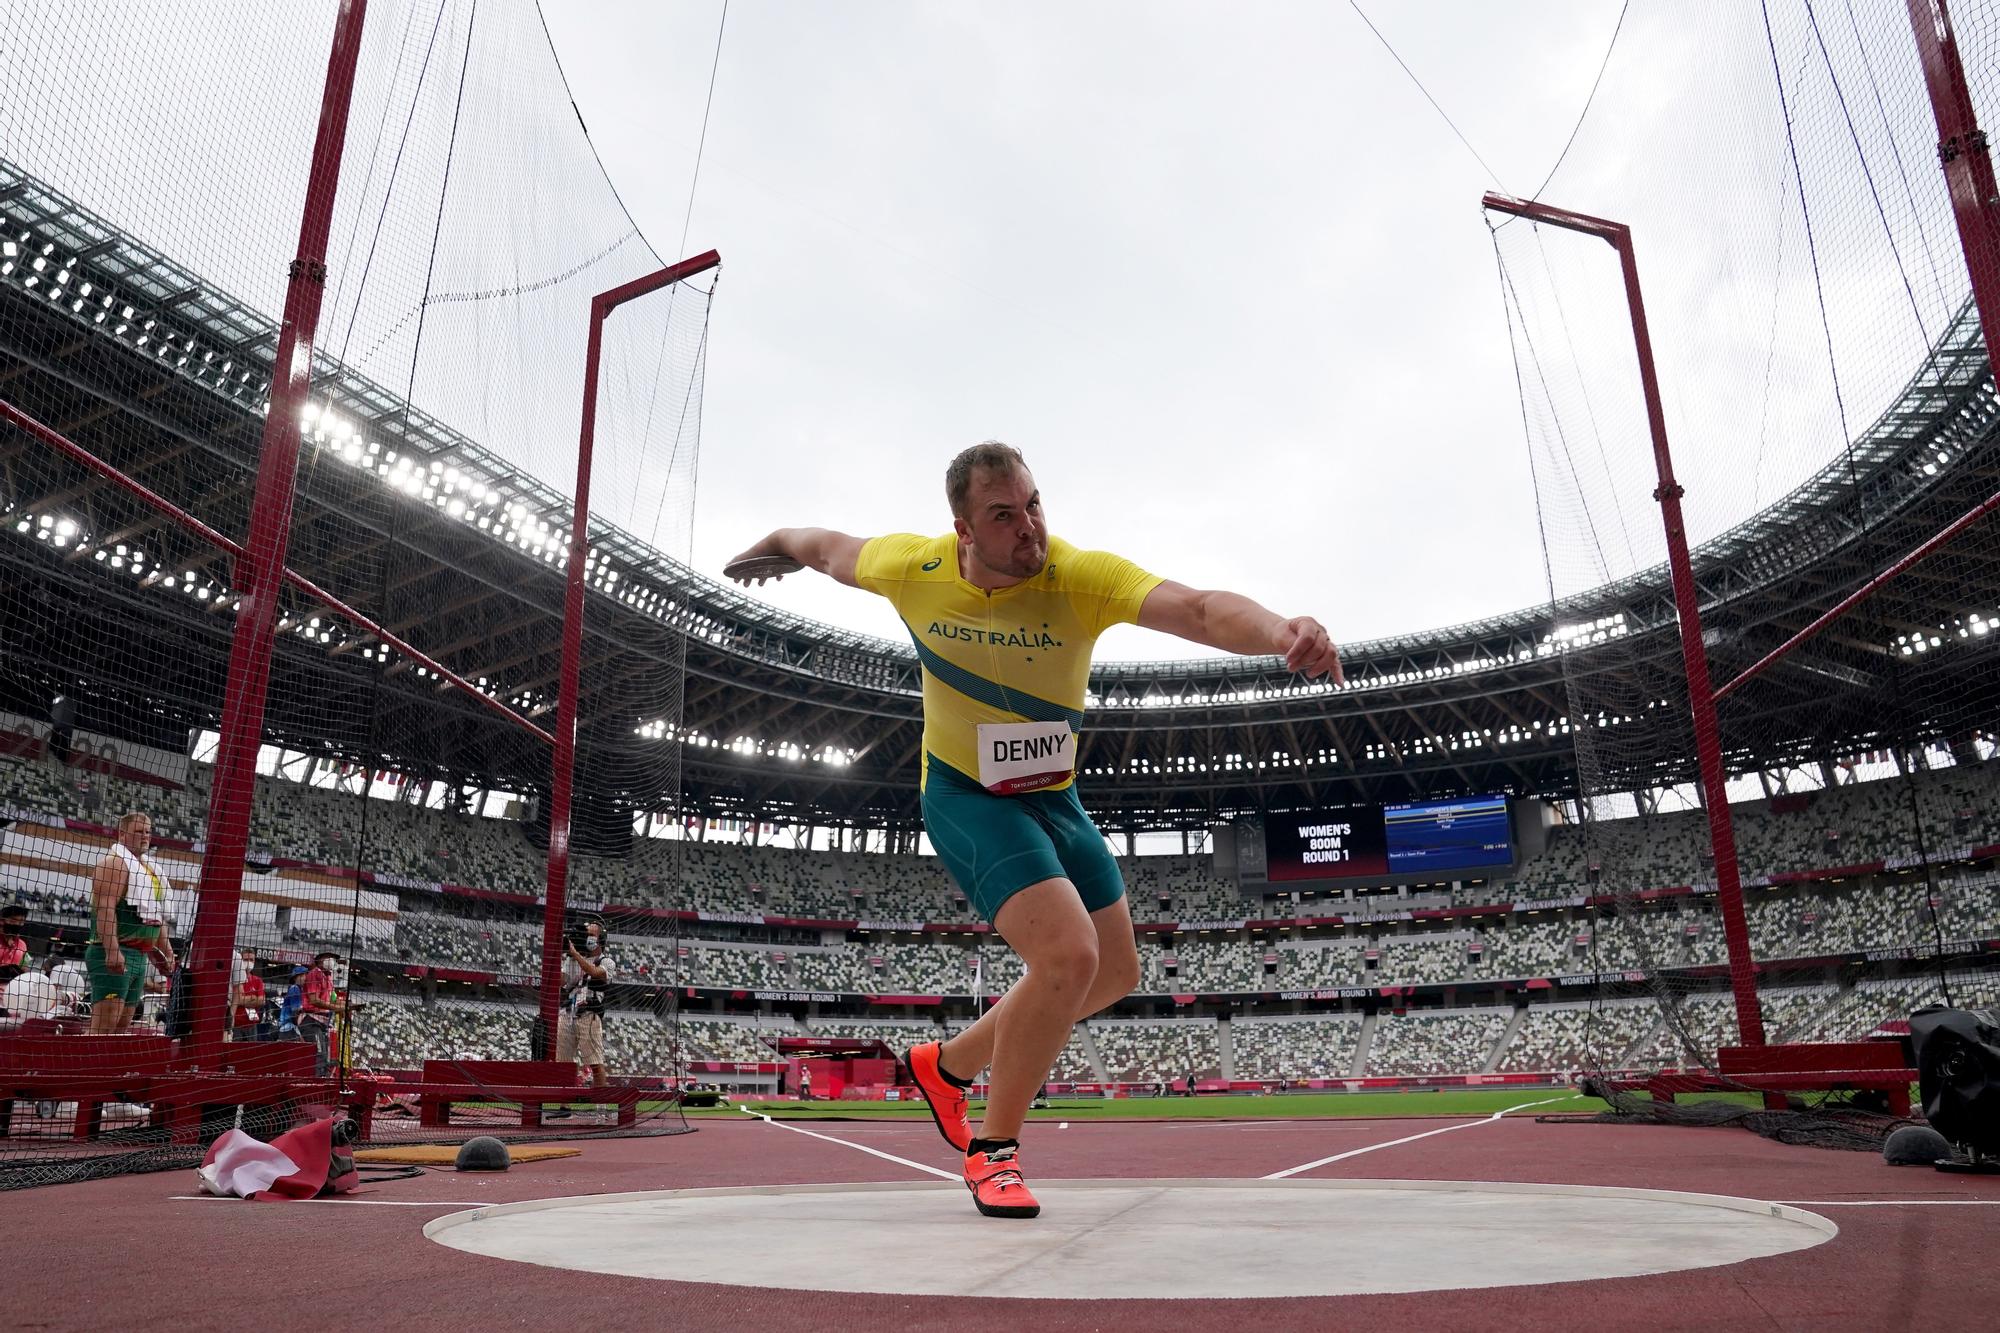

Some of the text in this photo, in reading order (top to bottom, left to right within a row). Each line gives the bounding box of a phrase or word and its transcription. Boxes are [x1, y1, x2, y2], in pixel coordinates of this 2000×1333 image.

[928, 621, 1056, 648] AUSTRALIA
[993, 733, 1068, 762] DENNY
[1010, 781, 1027, 789] TOKYO
[1298, 823, 1351, 838] WOMEN'S
[1310, 837, 1341, 850] 800M
[1303, 849, 1349, 864] ROUND 1
[1599, 974, 1623, 983] 800M
[754, 992, 787, 1001] WOMEN'S
[789, 993, 810, 1001] 800M
[812, 994, 835, 1002] ROUND
[1281, 991, 1316, 1000] WOMEN'S
[1317, 990, 1339, 999] 800M
[1341, 989, 1366, 998] ROUND
